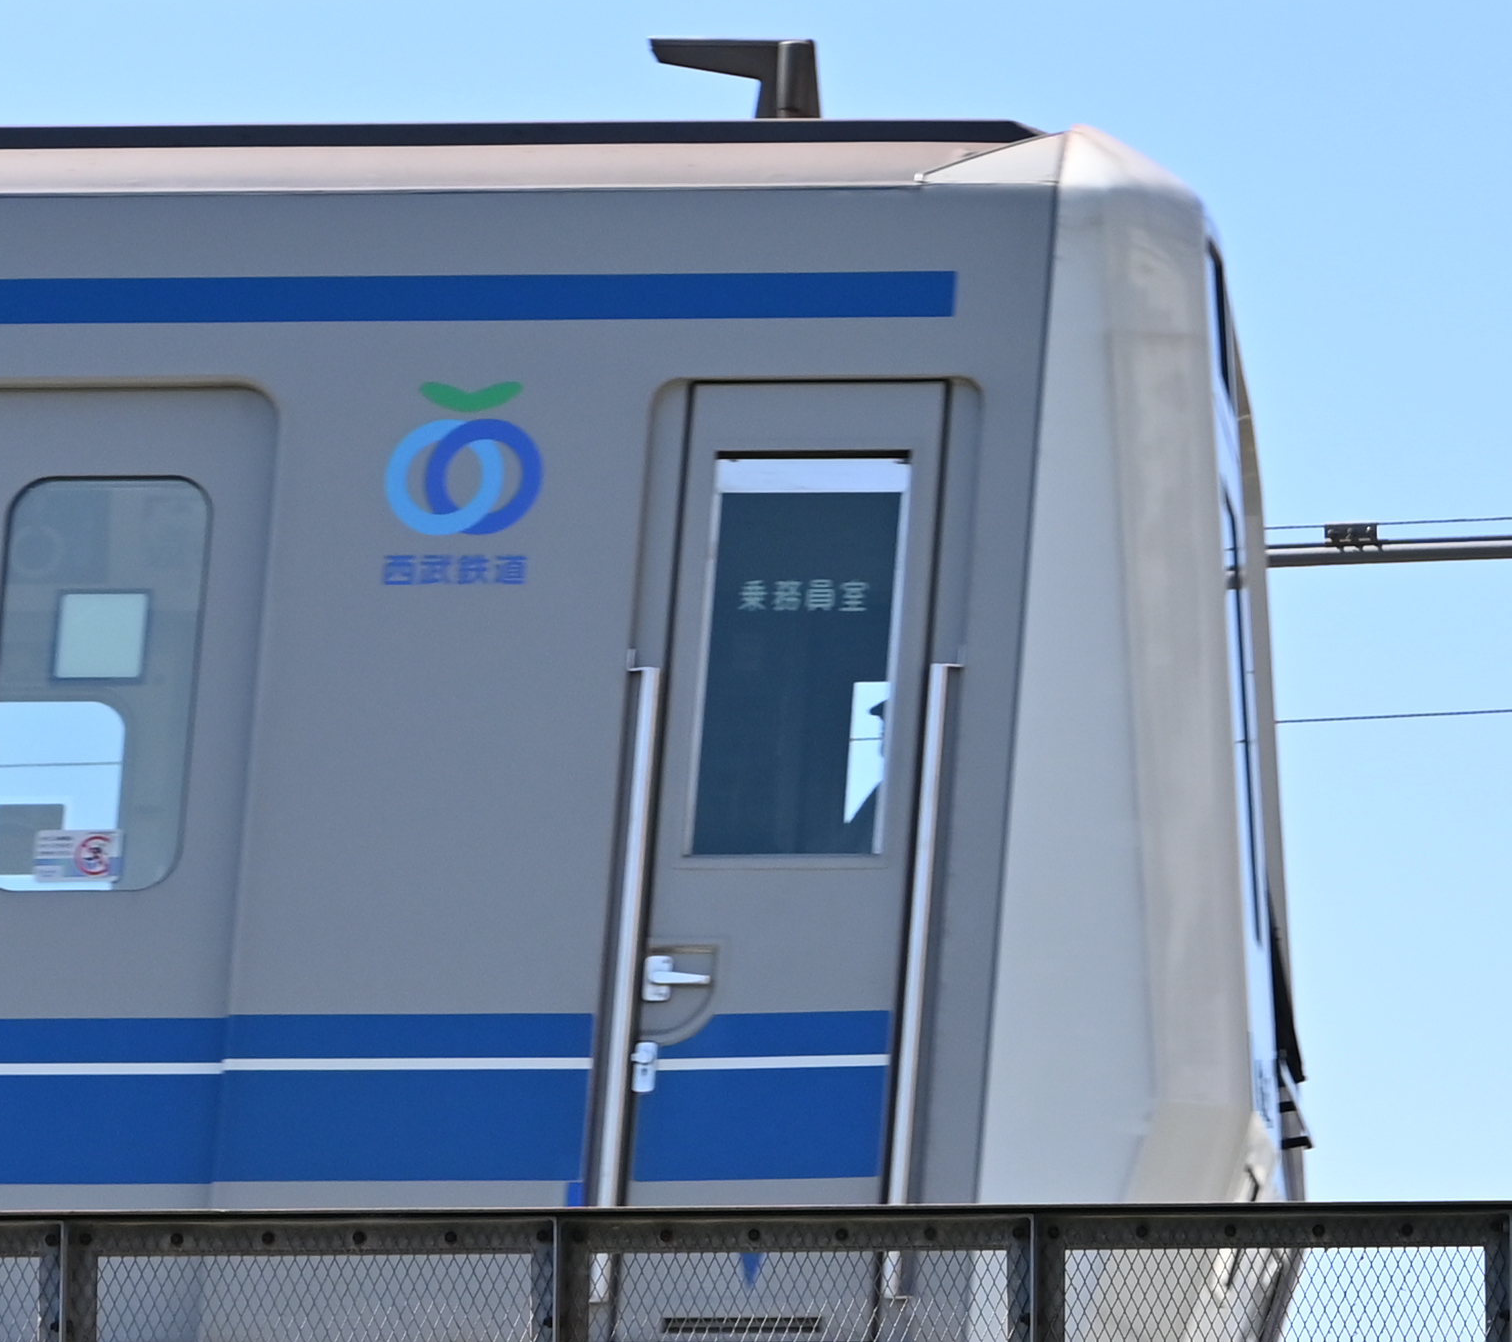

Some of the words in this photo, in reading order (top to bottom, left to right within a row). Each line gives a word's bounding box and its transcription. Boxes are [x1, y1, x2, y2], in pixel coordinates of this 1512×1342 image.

[383, 555, 528, 585] 西武鉄道
[738, 578, 869, 611] 乗務員室
